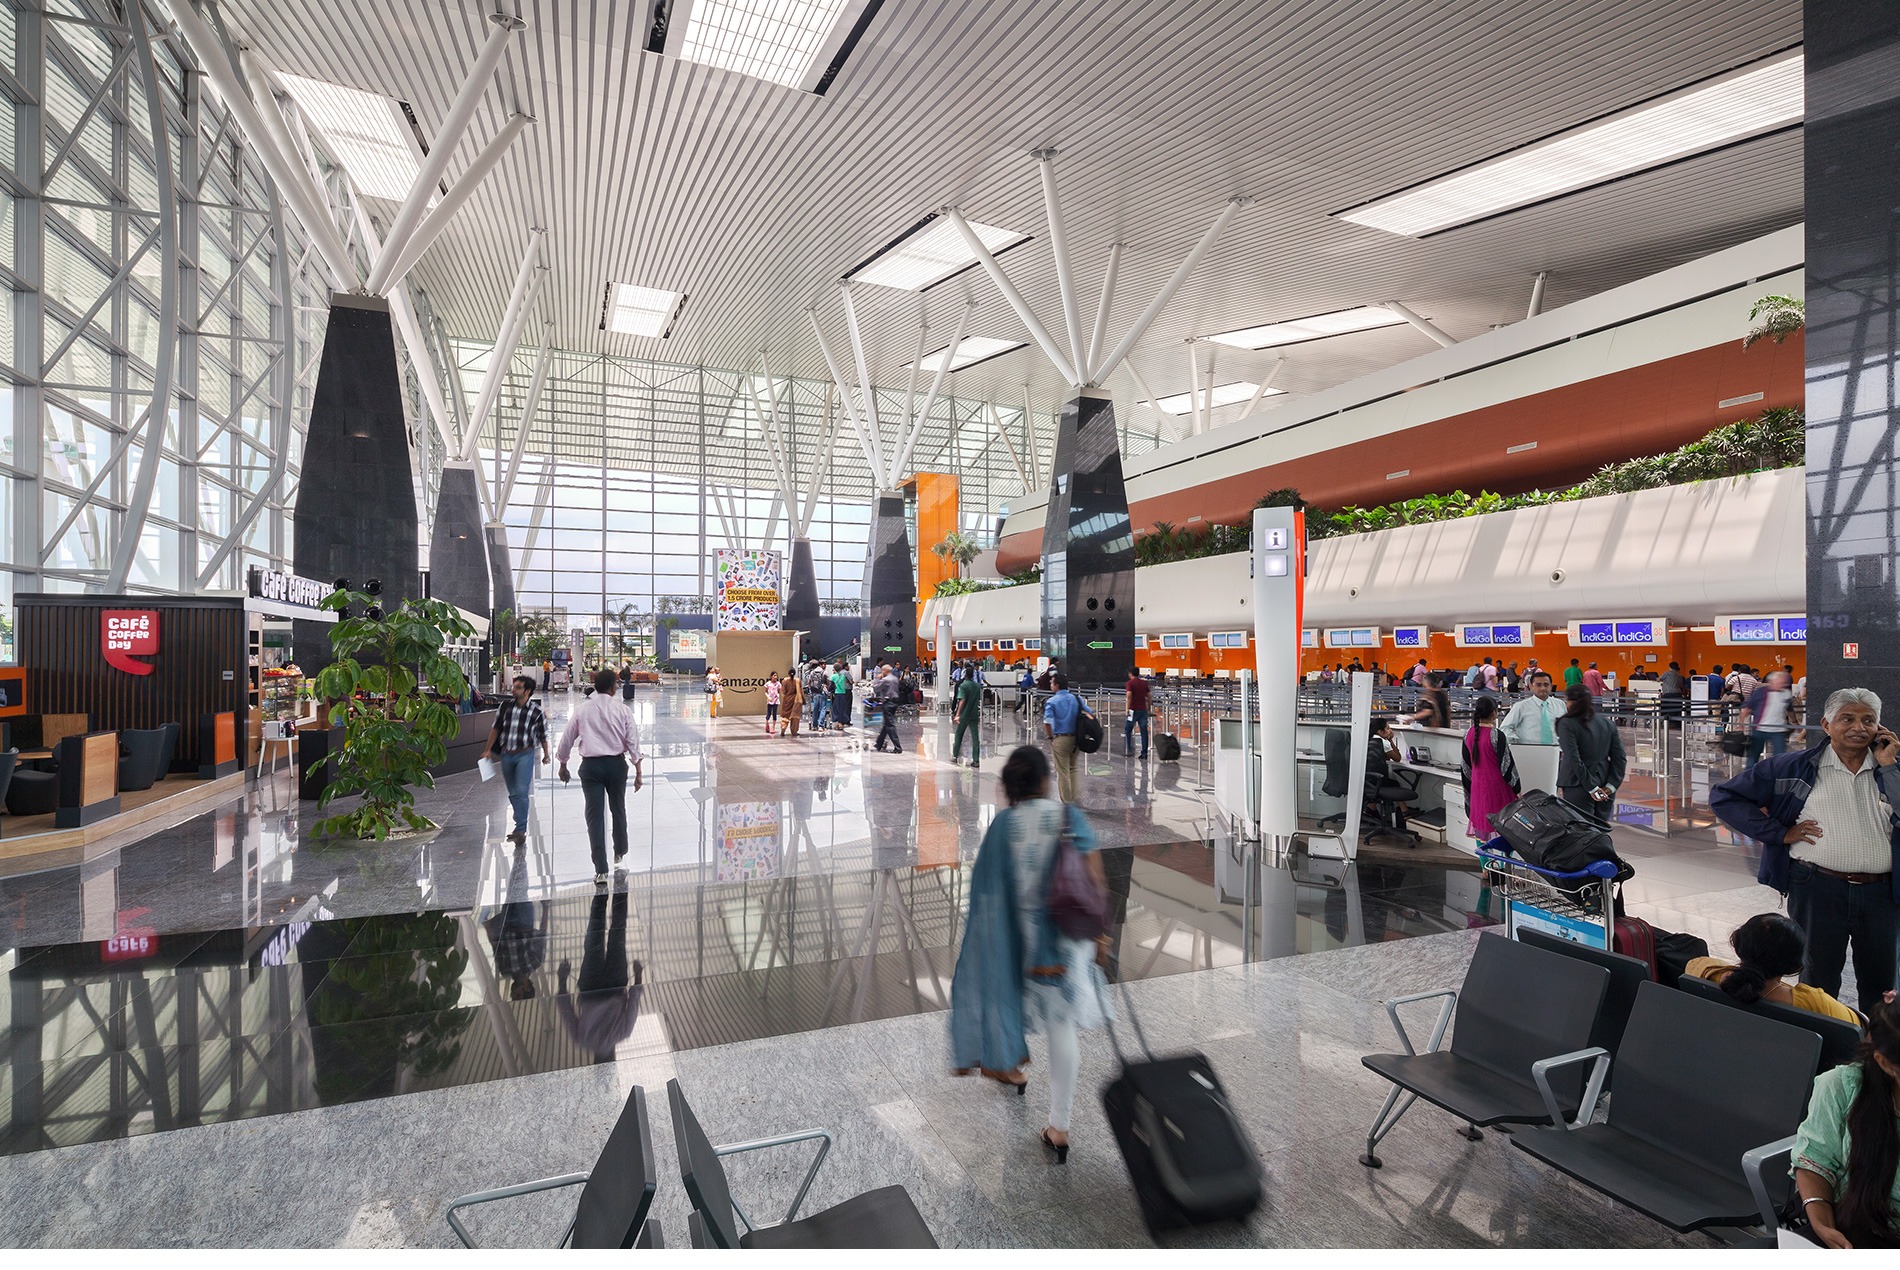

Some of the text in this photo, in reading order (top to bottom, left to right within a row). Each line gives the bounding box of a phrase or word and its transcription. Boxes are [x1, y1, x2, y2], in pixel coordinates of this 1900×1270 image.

[108, 615, 149, 630] Café
[108, 630, 149, 640] Coffee
[1654, 627, 1662, 636] 30
[1718, 626, 1727, 636] 31
[1732, 629, 1773, 639] IndiGo
[1397, 636, 1419, 645] IndiGo
[1466, 634, 1490, 643] IndiGo
[1494, 634, 1520, 643] IndiGo
[1581, 632, 1613, 642] IndiGo
[1618, 631, 1651, 642] IndiGo
[108, 640, 132, 650] Day
